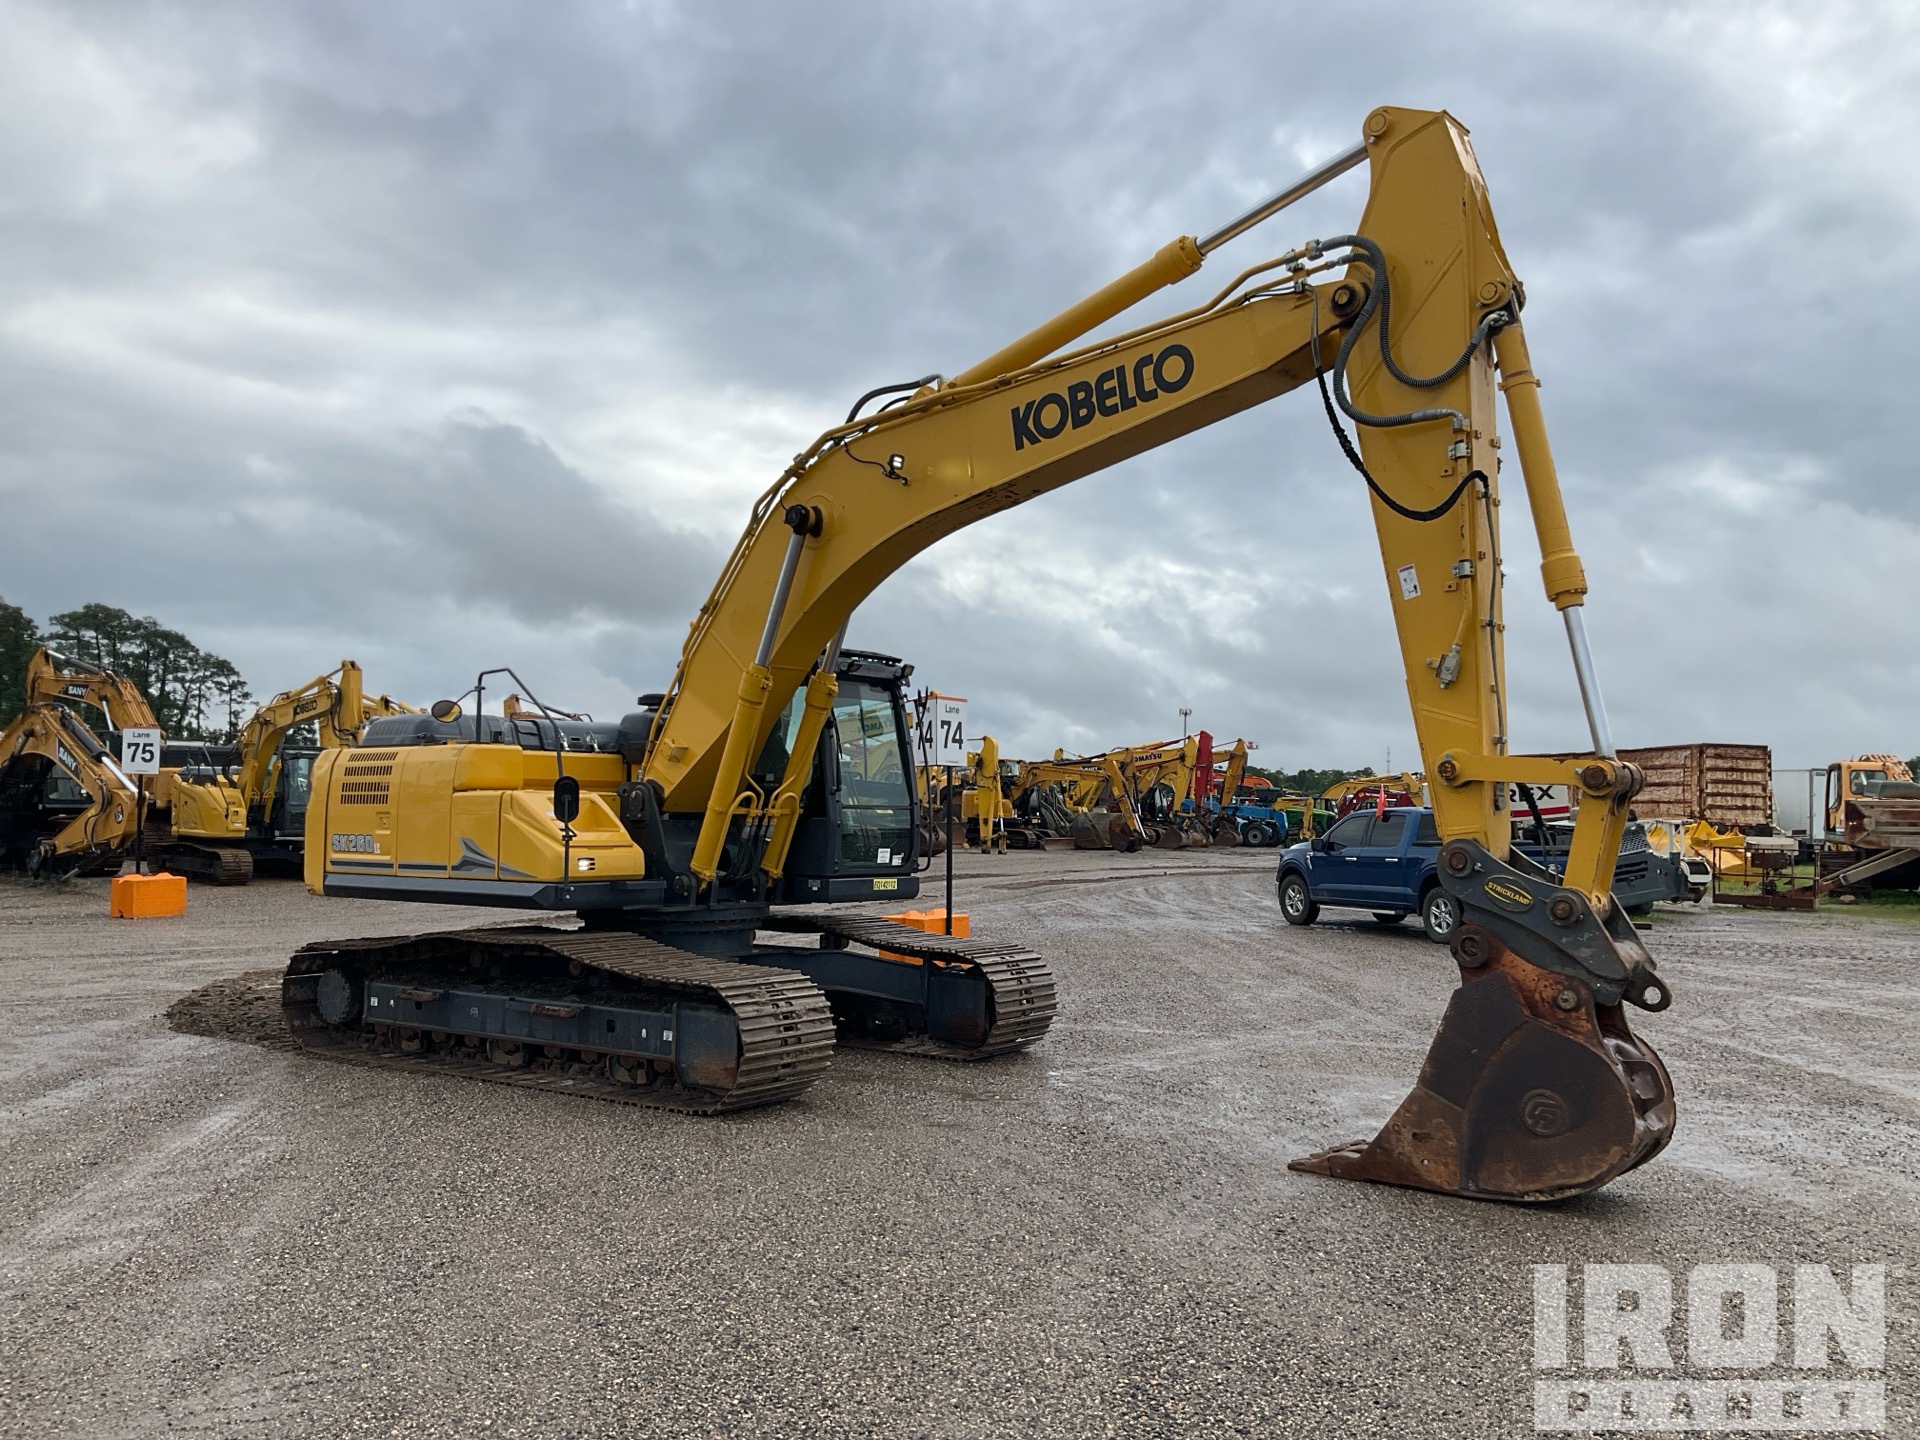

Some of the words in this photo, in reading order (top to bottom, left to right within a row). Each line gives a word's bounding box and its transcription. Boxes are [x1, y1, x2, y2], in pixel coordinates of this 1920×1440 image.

[1011, 344, 1194, 451] KOBELCO
[68, 686, 86, 696] SANY
[945, 704, 960, 714] Lane
[941, 720, 963, 750] 74
[59, 747, 77, 771] SANY
[127, 743, 155, 763] 75
[1134, 752, 1162, 762] OMATSU
[332, 834, 374, 853] SK260
[1487, 881, 1530, 905] STRICKLAND
